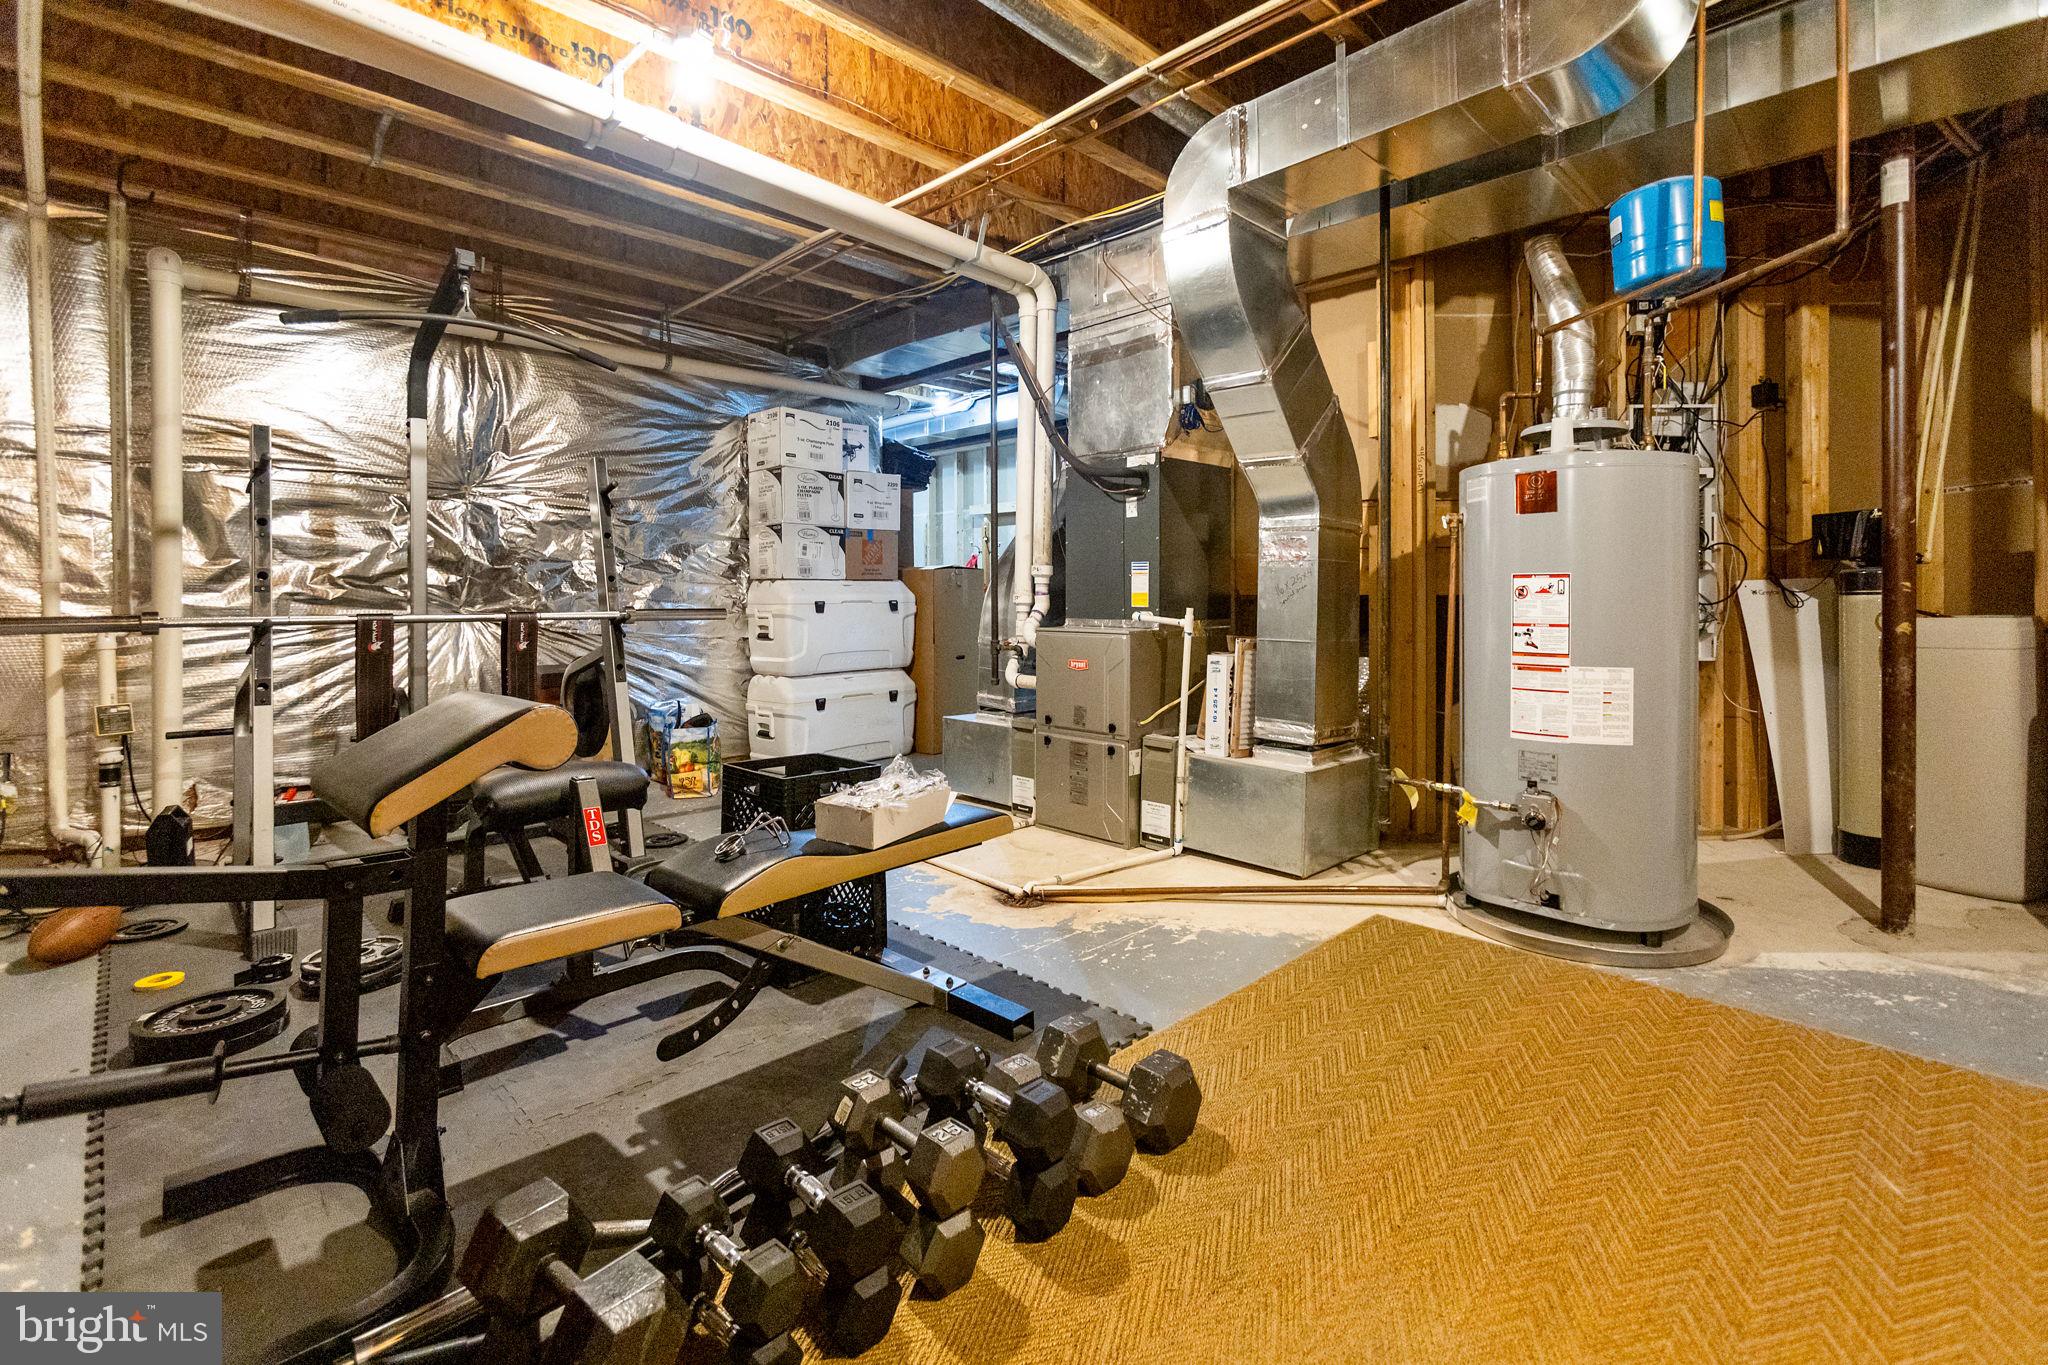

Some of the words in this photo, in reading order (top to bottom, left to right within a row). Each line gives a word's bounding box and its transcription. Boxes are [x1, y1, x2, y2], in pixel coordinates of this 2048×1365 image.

[571, 41, 614, 74] 130
[587, 808, 602, 842] TDS
[932, 1121, 962, 1142] 25
